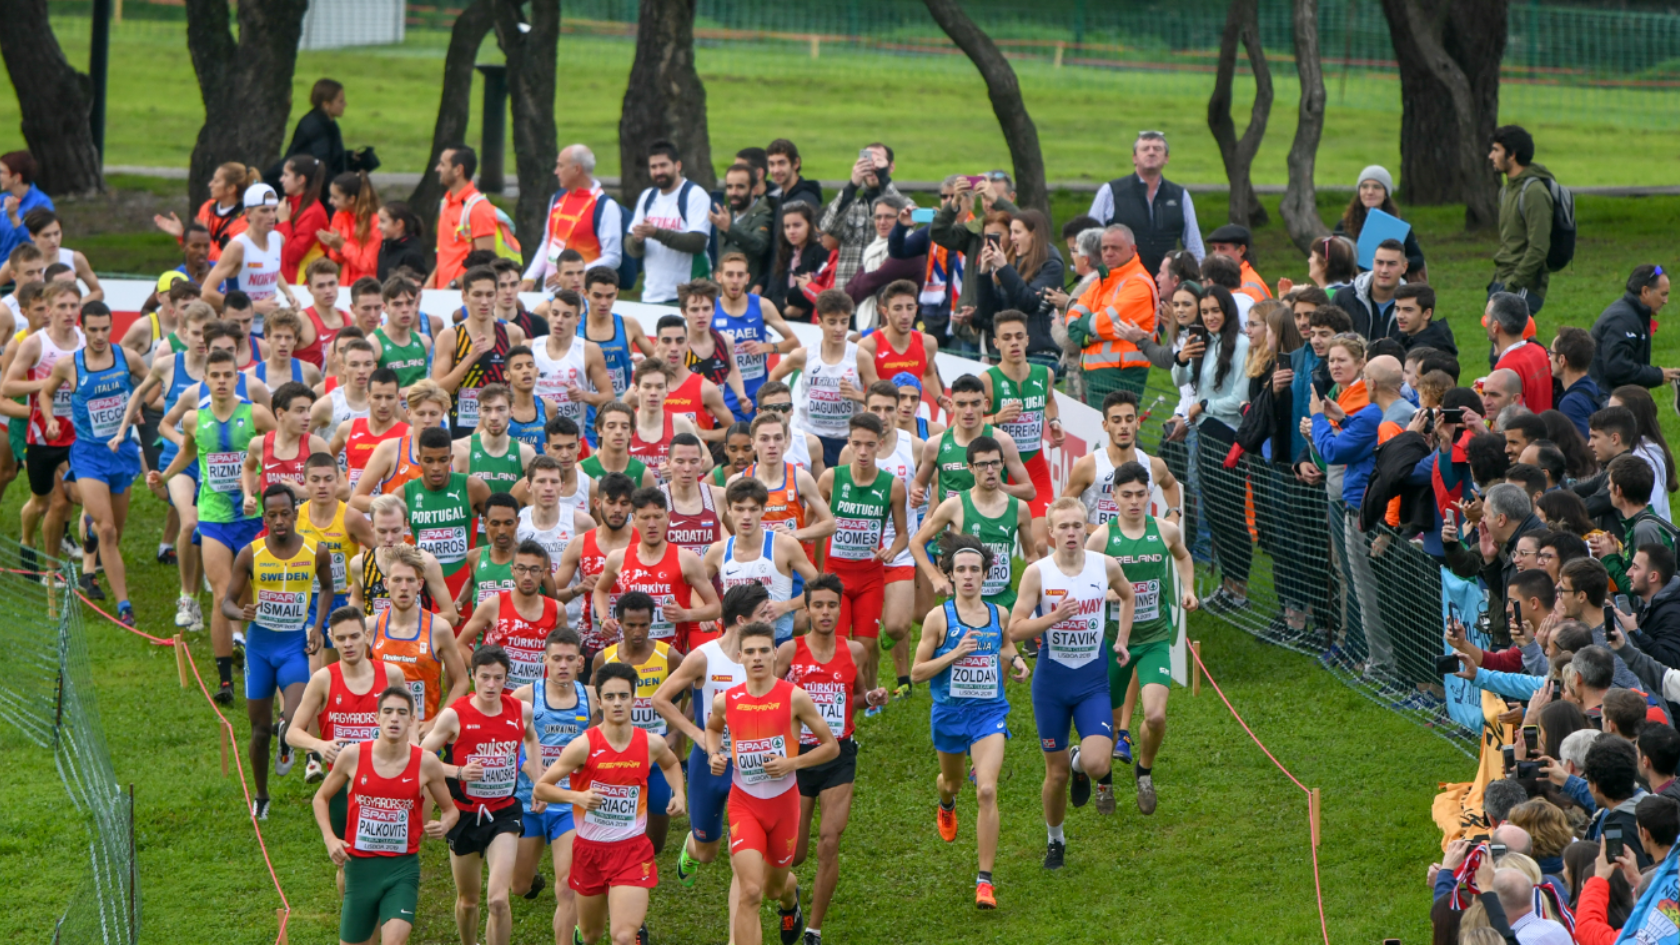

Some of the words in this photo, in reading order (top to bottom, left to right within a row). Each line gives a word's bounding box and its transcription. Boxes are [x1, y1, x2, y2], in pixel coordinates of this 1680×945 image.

[94, 381, 120, 395] ITALIA
[809, 400, 853, 414] DAGUINOS
[1001, 395, 1046, 410] POTUGAL
[1002, 423, 1040, 438] PEREIRA
[208, 454, 239, 464] SPAR
[942, 462, 968, 471] IREL
[411, 506, 467, 524] PORTUGAL
[838, 500, 883, 516] PORTUGAL
[836, 519, 868, 529] SPAR
[420, 530, 453, 540] SPAR
[668, 529, 713, 543] CROATIA
[835, 530, 878, 545] GOMES
[420, 540, 466, 555] BARROS
[260, 572, 309, 582] SWEDEN
[259, 590, 295, 603] SPAR
[260, 601, 303, 617] ISMAIL
[1051, 597, 1104, 616] NWAY
[1052, 620, 1087, 630] SPAR
[1052, 631, 1098, 646] STAVIK
[506, 649, 537, 662] SPAR
[954, 657, 989, 667] SPAR
[953, 668, 996, 683] ZOLDAN
[810, 693, 834, 703] PAR
[335, 727, 370, 738] SPAR
[545, 724, 577, 734] UKRAINE
[737, 741, 771, 753] SPAR
[361, 808, 397, 822] SPAR
[359, 819, 407, 837] PALKOVITS
